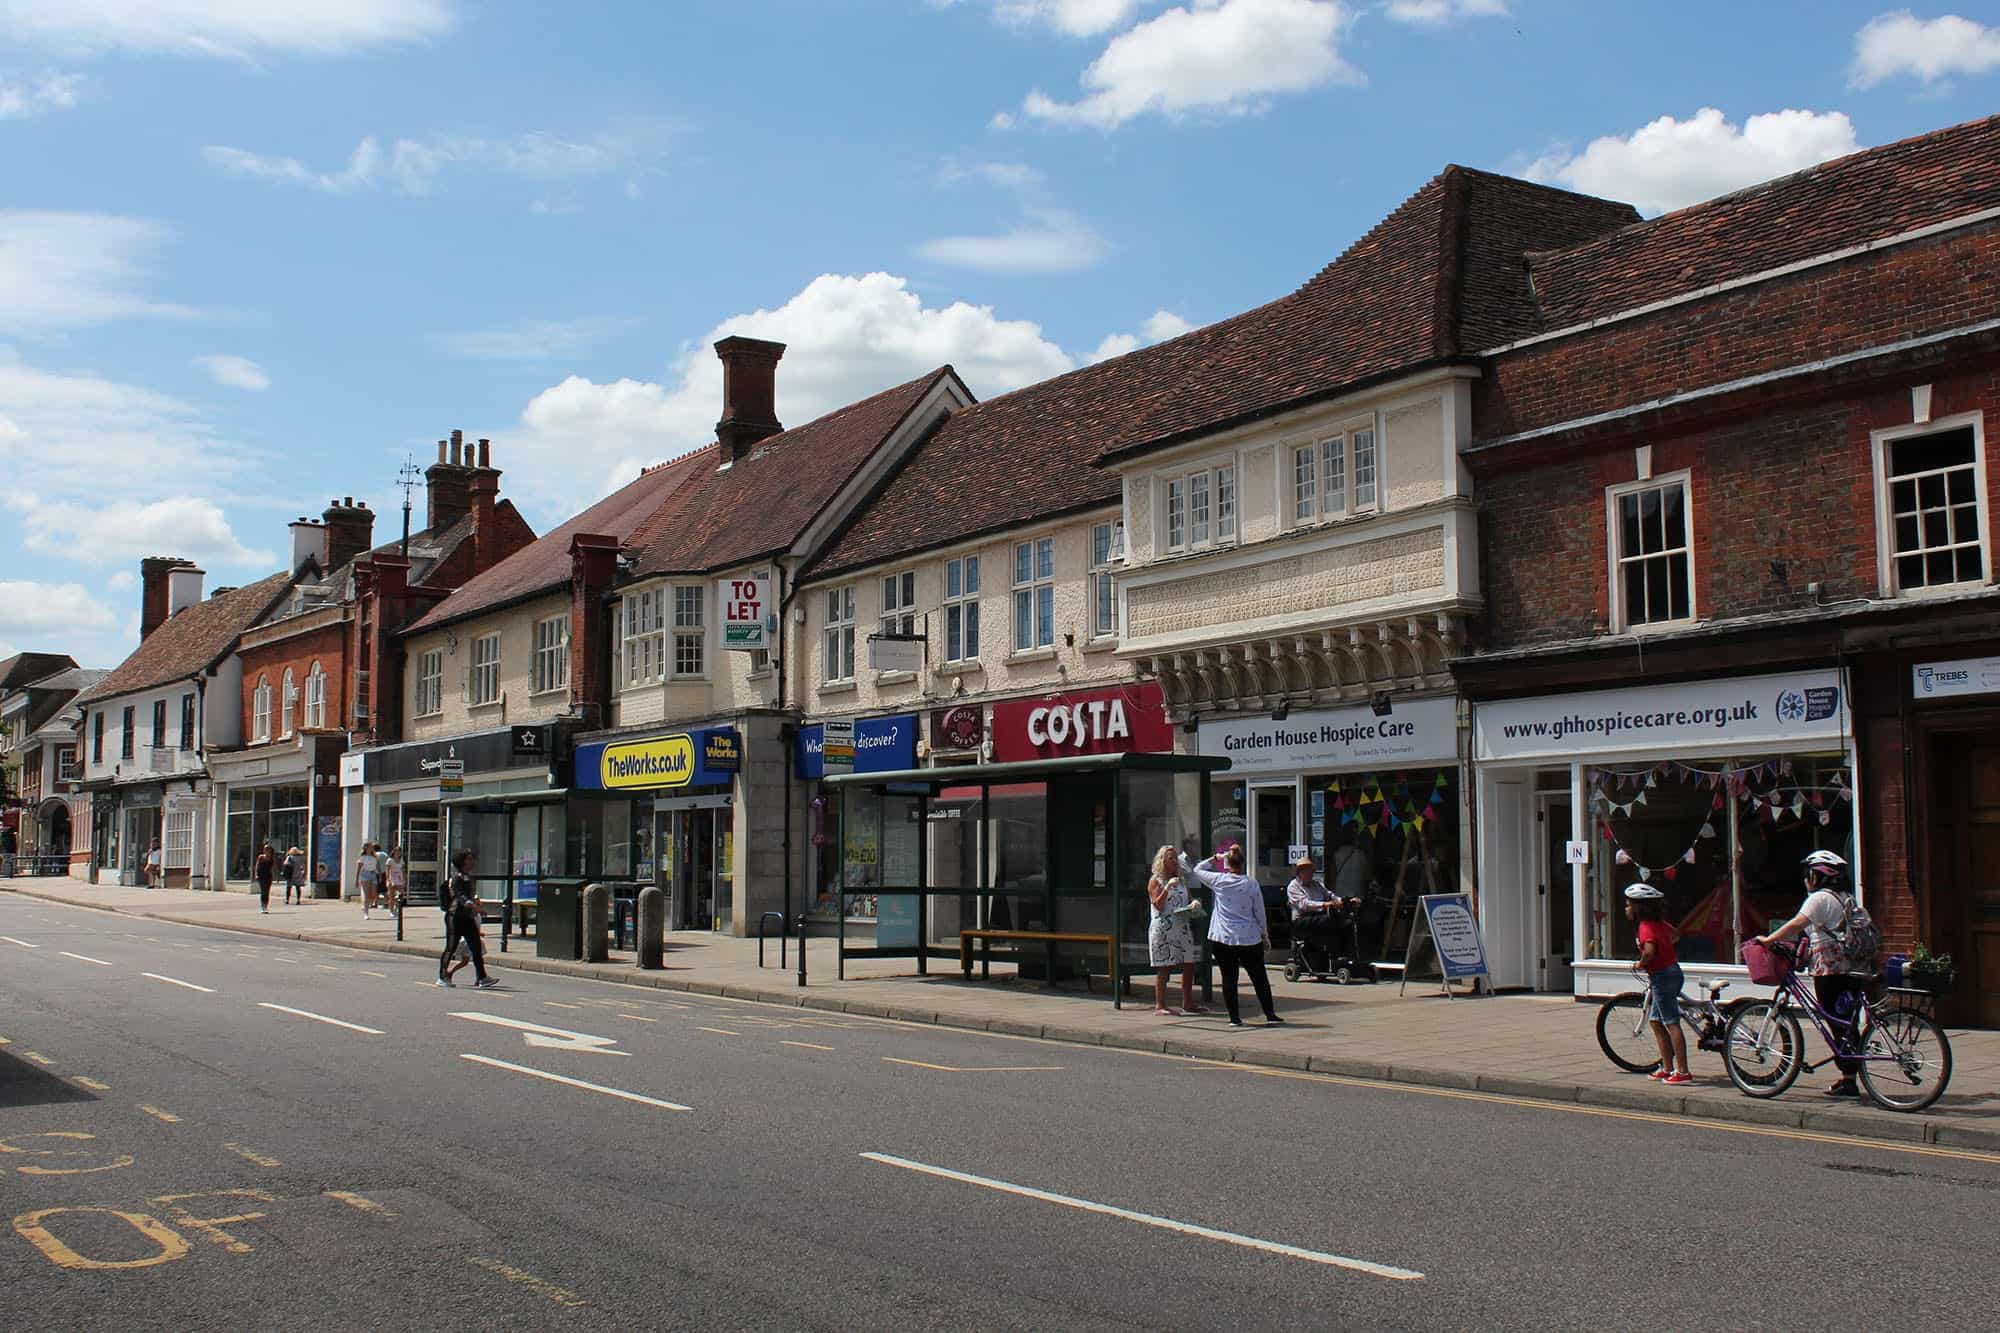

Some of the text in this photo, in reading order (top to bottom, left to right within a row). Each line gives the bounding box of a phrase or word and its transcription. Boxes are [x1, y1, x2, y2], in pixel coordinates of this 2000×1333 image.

[731, 581, 756, 600] TO
[728, 602, 761, 620] LET
[1935, 671, 1968, 681] TREBES
[1027, 699, 1129, 748] COSTA
[1503, 700, 1758, 740] www.ghhospicecare.org.uk
[712, 736, 732, 747] The
[806, 739, 824, 753] Wha
[857, 726, 898, 750] discover?
[1224, 720, 1414, 750] Garden House Hospice Care
[706, 746, 738, 758] Works
[607, 747, 687, 778] TheWorks.co.uk
[1290, 850, 1306, 860] OUT
[1572, 847, 1583, 858] IN
